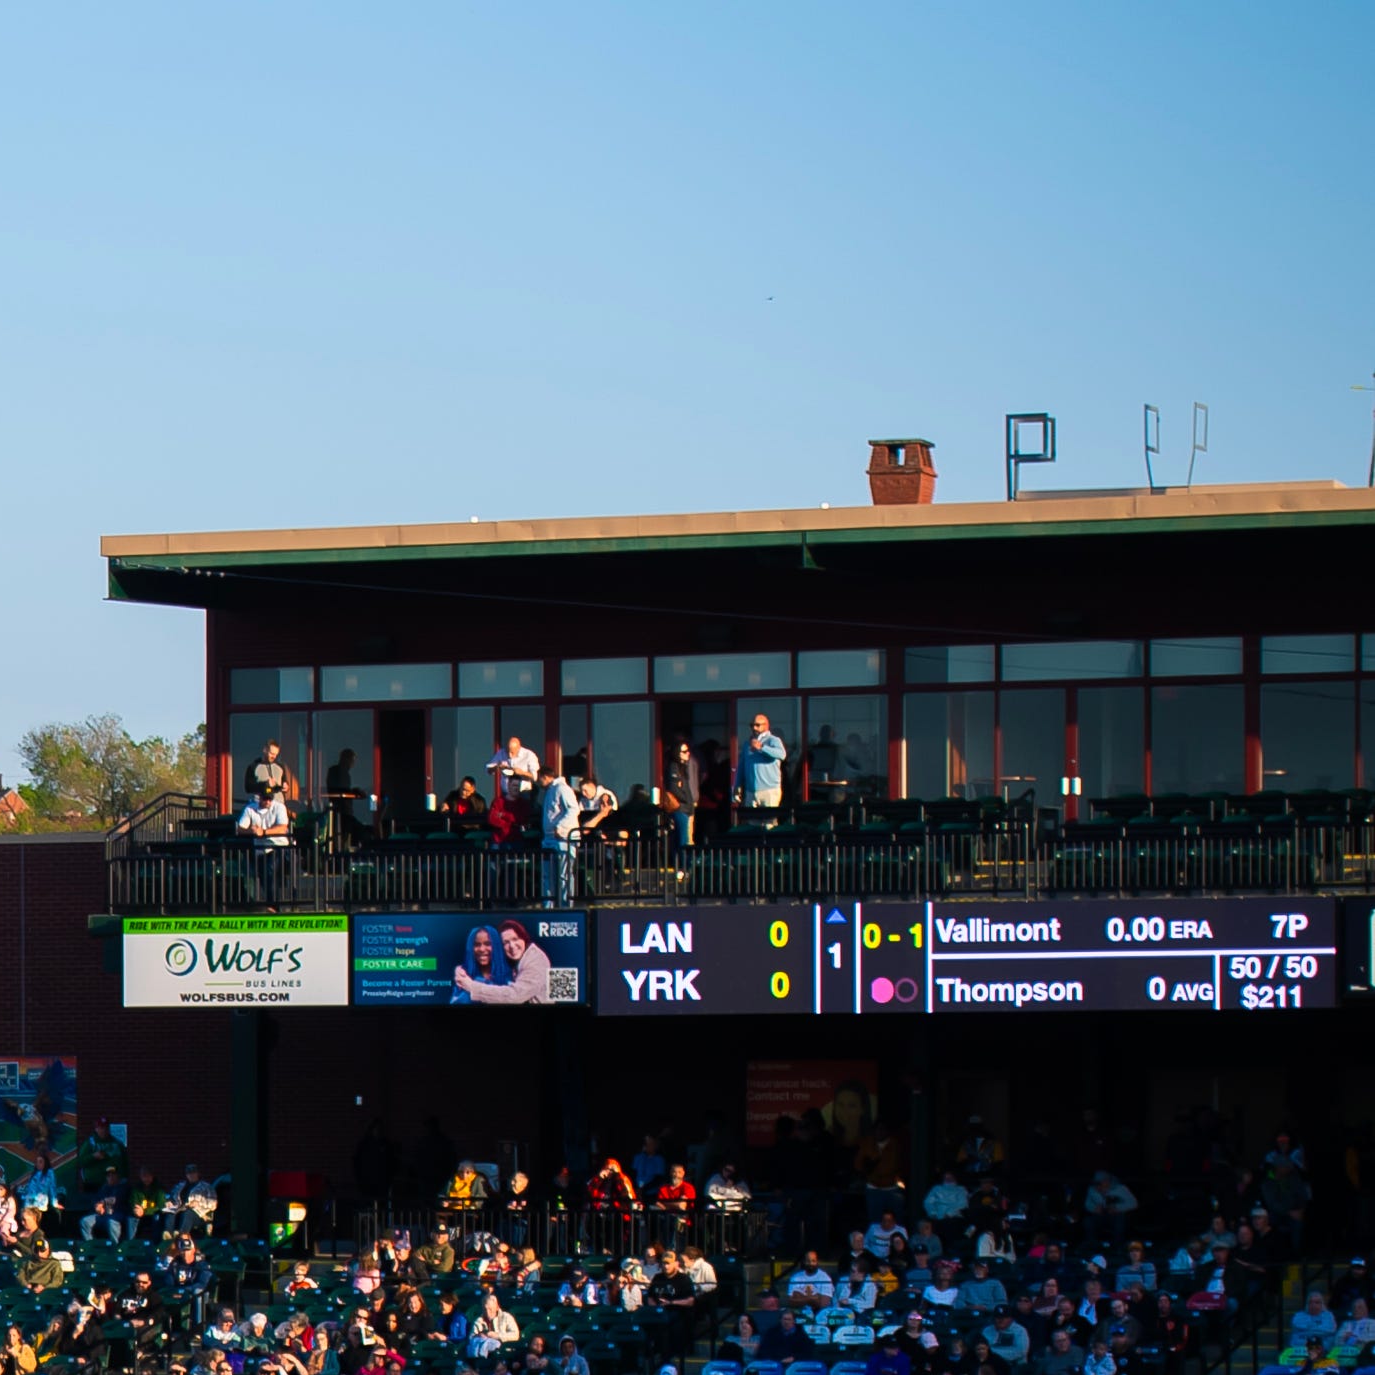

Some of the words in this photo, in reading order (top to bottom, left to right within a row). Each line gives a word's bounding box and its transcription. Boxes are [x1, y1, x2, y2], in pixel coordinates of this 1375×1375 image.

[129, 922, 147, 931] RIDE
[150, 922, 171, 931] WITH
[174, 921, 189, 931] THE
[219, 920, 246, 930] RALLY
[248, 920, 269, 929] WITH
[272, 920, 287, 929] THE
[288, 919, 343, 929] REVOLUTION!
[362, 925, 394, 933] FOSTER
[936, 917, 1062, 944] Vallimont
[1107, 918, 1166, 941] 0.00
[1170, 921, 1214, 939] ERA
[1270, 914, 1308, 939] 7P
[550, 928, 578, 937] RIDGE
[621, 923, 692, 953] LAN
[770, 921, 789, 948] 0
[863, 924, 881, 949] 0
[910, 923, 923, 948] 1
[362, 936, 394, 945] FOSTER
[362, 947, 394, 956] FOSTER
[396, 946, 415, 957] hope
[828, 942, 841, 968] 1
[362, 960, 397, 969] FOSTER
[400, 960, 423, 969] CARE
[1230, 957, 1262, 979] 50
[1286, 956, 1317, 979] 50
[246, 980, 267, 988] BUS
[271, 980, 302, 988] LINES
[362, 980, 392, 988] Become
[401, 980, 425, 988] Foster
[427, 979, 452, 987] Parent
[622, 969, 701, 1001] YRK
[771, 972, 790, 998] 0
[180, 992, 290, 1002] WOLFSBUS.COM
[936, 978, 1083, 1007] Thompson
[1147, 977, 1166, 1001] 0
[1172, 983, 1214, 1001] AVG
[1240, 986, 1302, 1010] $211
